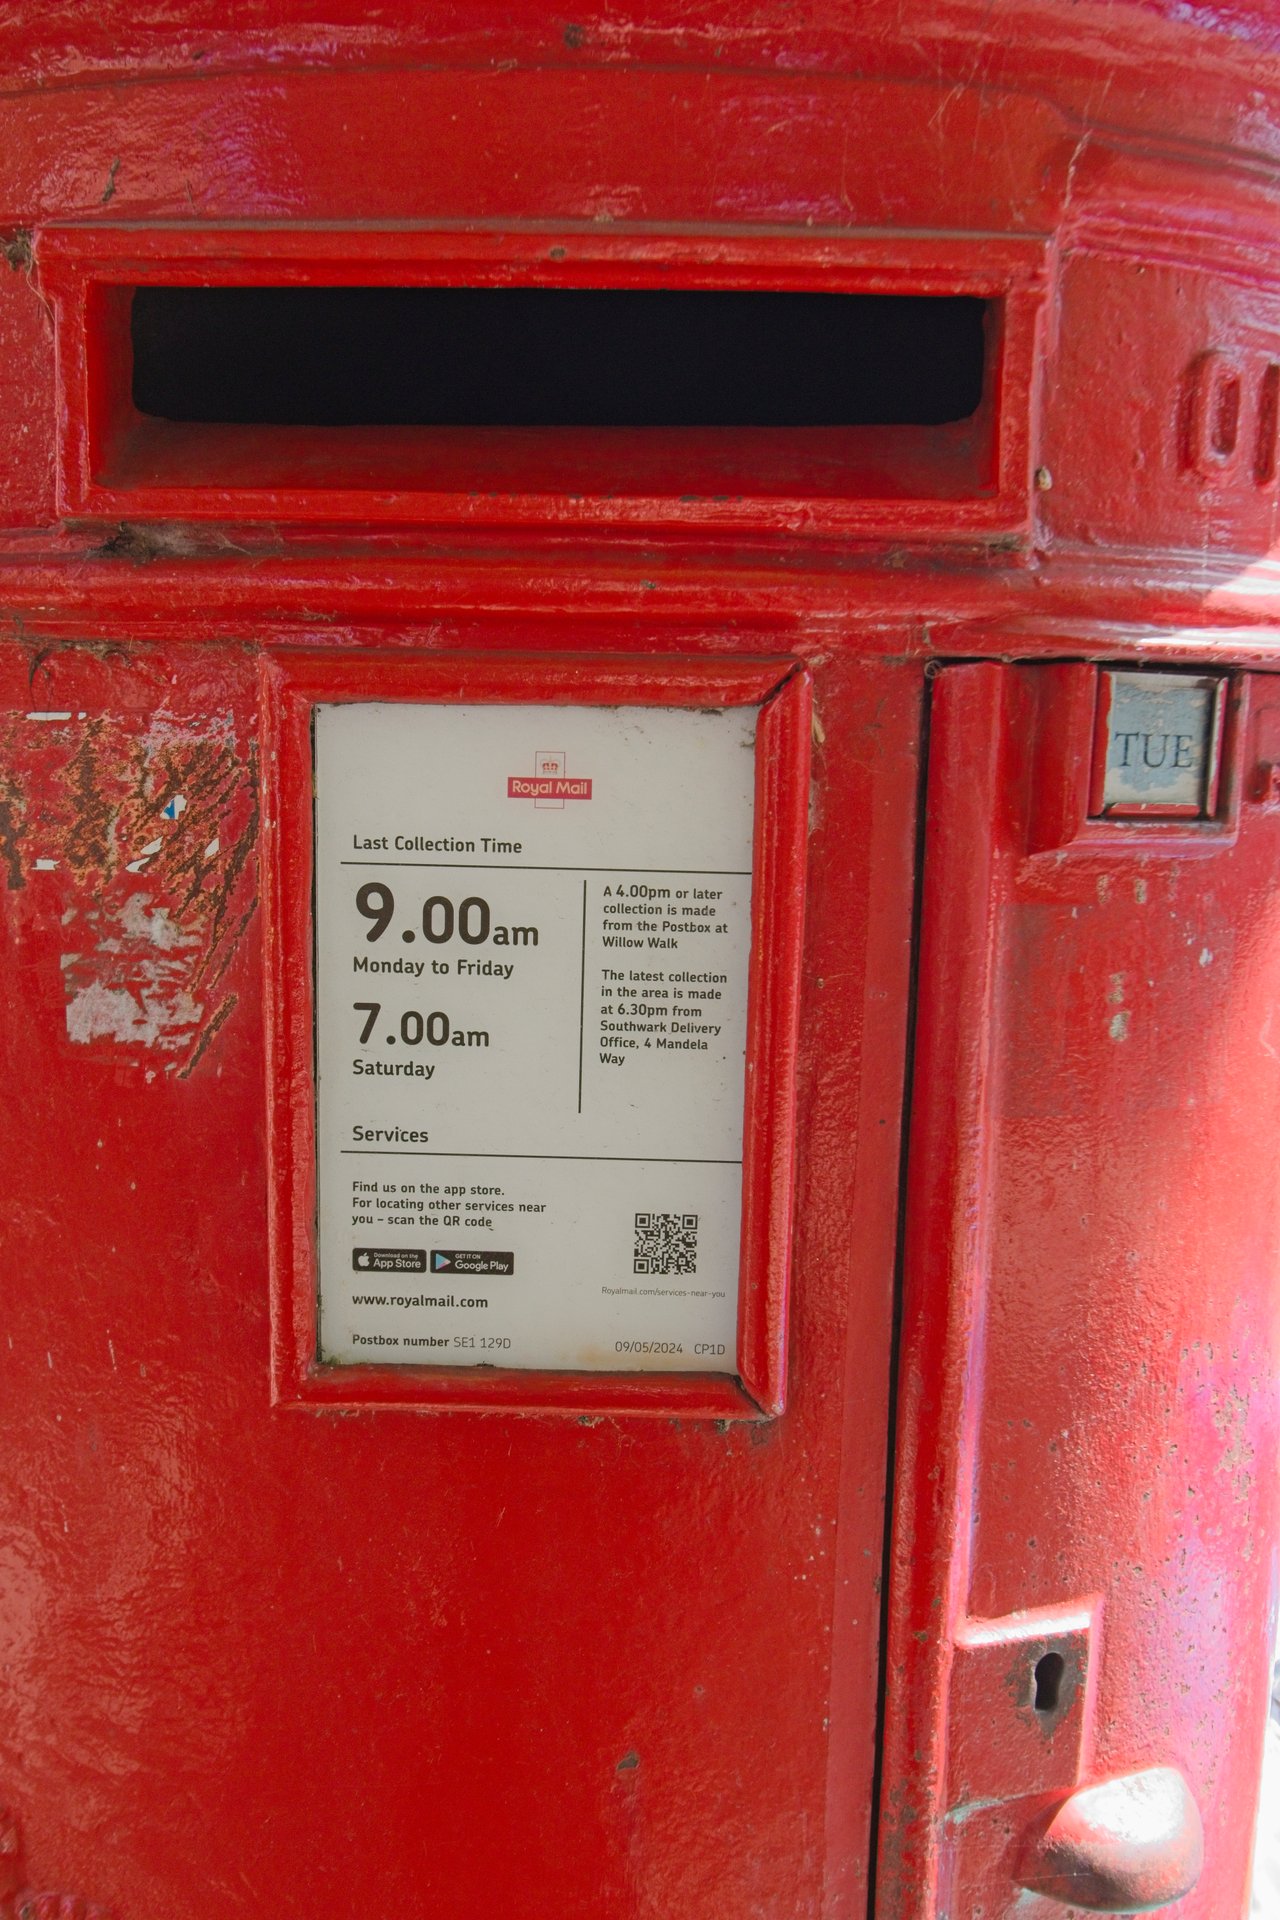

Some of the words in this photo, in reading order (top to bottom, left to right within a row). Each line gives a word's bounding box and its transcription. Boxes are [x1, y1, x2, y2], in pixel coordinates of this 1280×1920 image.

[1114, 732, 1193, 769] TUE
[513, 780, 552, 796] Royal
[555, 782, 588, 794] Mail
[353, 835, 389, 850] Last
[395, 836, 474, 852] Collection
[480, 838, 523, 853] Time
[603, 886, 612, 897] A
[615, 885, 671, 900] 4.00pm
[675, 891, 690, 899] or
[693, 888, 723, 900] later
[603, 903, 663, 915] collection
[667, 904, 678, 916] is
[681, 906, 716, 917] made
[602, 920, 633, 931] from
[636, 921, 658, 932] the
[662, 921, 711, 933] Postbox
[714, 924, 729, 934] at
[602, 936, 644, 948] Willow
[647, 937, 678, 949] Walk
[354, 957, 424, 977] Monday
[430, 960, 450, 974] to
[458, 959, 514, 979] Friday
[601, 970, 625, 981] The
[629, 971, 665, 982] latest
[668, 972, 728, 984] collection
[601, 986, 613, 997] in
[616, 987, 638, 998] the
[641, 990, 669, 999] area
[673, 988, 684, 999] is
[687, 989, 722, 1000] made
[600, 1005, 614, 1015] at
[617, 1003, 668, 1018] 6.30pm
[672, 1006, 702, 1017] from
[600, 1020, 667, 1032] Southwark
[670, 1022, 722, 1036] Delivery
[599, 1037, 640, 1049] Office,
[643, 1038, 652, 1049] 4
[656, 1038, 709, 1050] Mandela
[599, 1053, 626, 1066] Way
[353, 1059, 435, 1080] Saturday
[353, 1126, 428, 1142] Services
[352, 1181, 379, 1193] Find
[382, 1185, 397, 1193] us
[400, 1185, 416, 1194] on
[419, 1184, 440, 1194] the
[443, 1186, 466, 1197] app
[470, 1186, 505, 1196] store.
[352, 1197, 373, 1208] For
[376, 1198, 424, 1211] locating
[428, 1200, 462, 1211] other
[465, 1201, 515, 1212] services
[518, 1204, 547, 1213] near
[351, 1216, 374, 1226] you
[387, 1217, 415, 1225] scan
[418, 1216, 439, 1226] the
[443, 1216, 461, 1227] QR
[464, 1217, 493, 1227] code
[372, 1258, 394, 1270] App
[394, 1259, 422, 1269] Store
[454, 1260, 489, 1272] Google
[489, 1261, 509, 1273] Play
[351, 1295, 489, 1308] www.royalmail.com
[352, 1335, 399, 1346] Postbox
[402, 1337, 450, 1347] number
[453, 1337, 476, 1349] SE1
[480, 1338, 512, 1350] 129D
[614, 1341, 683, 1353] 09/05/2024
[694, 1344, 726, 1356] CP1D
